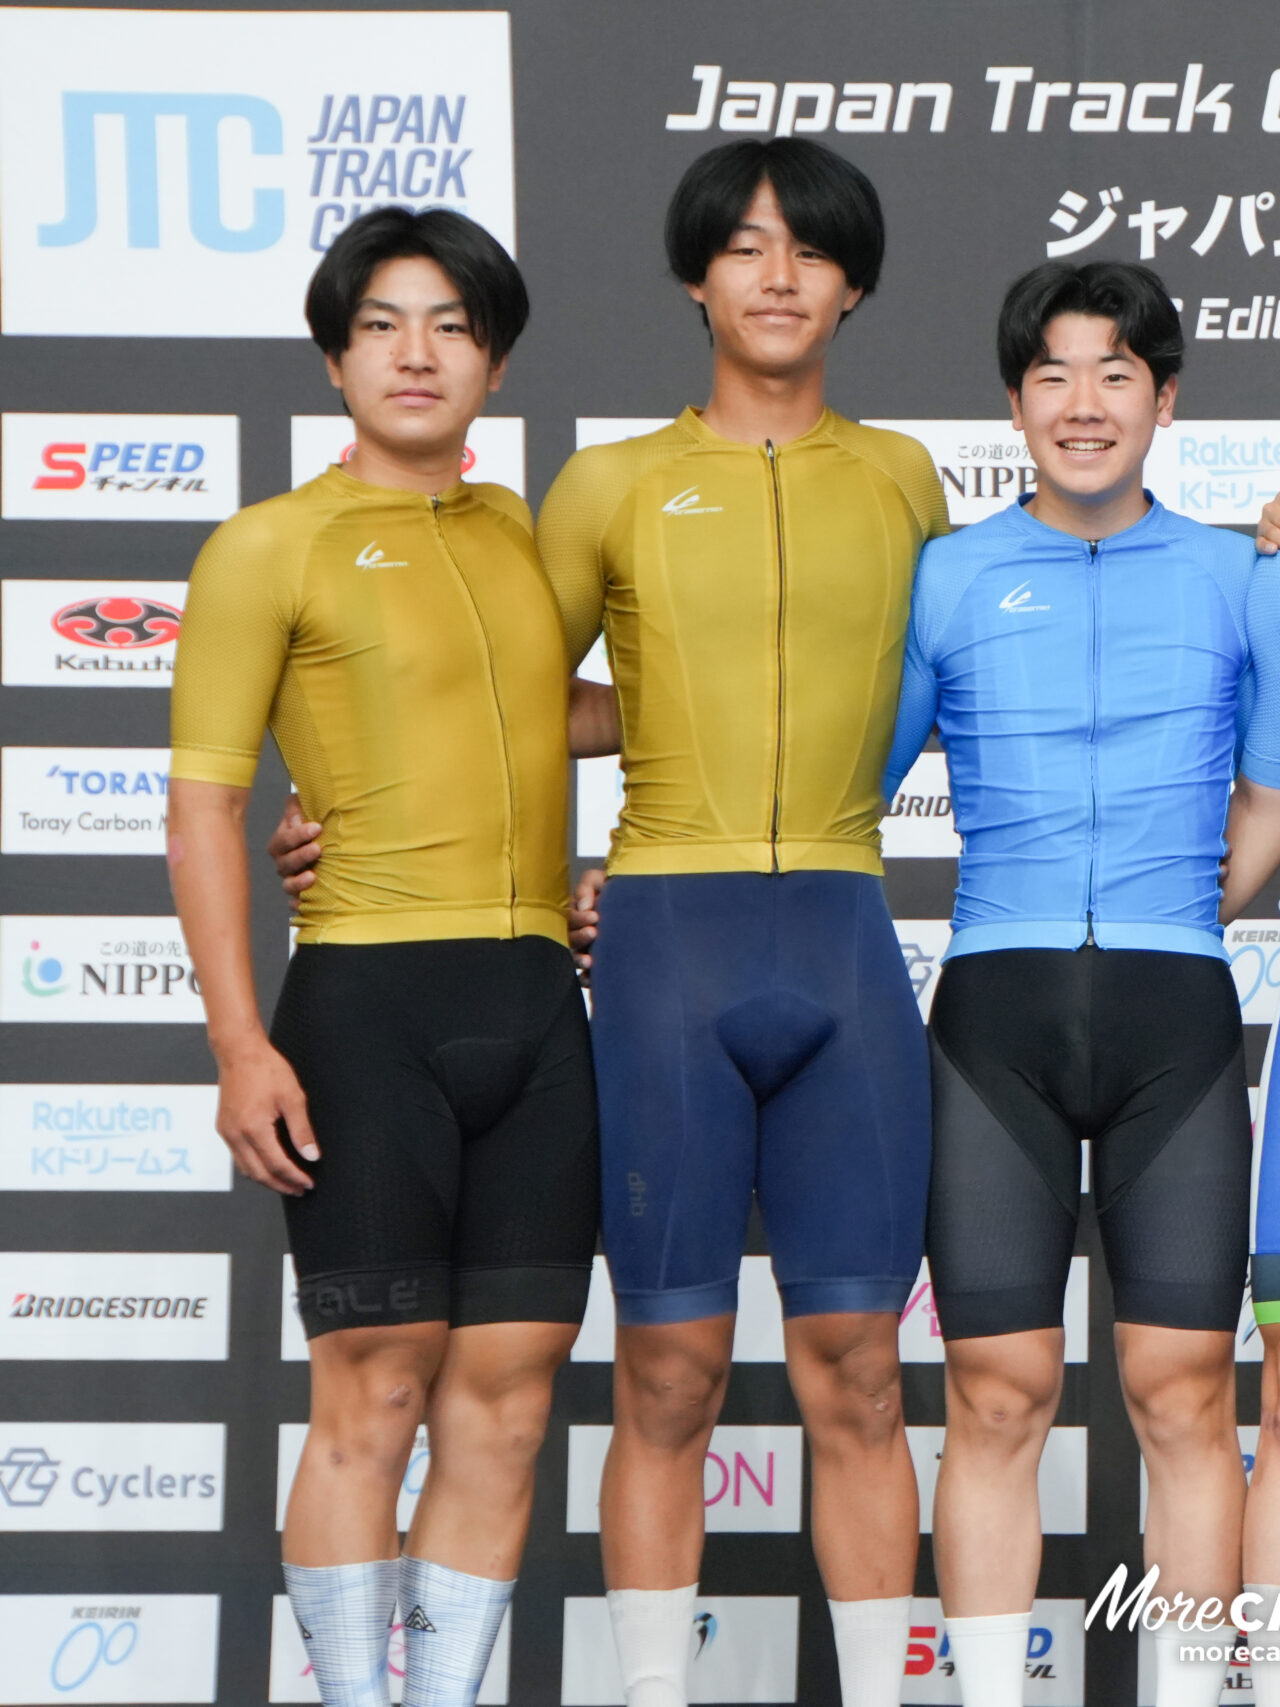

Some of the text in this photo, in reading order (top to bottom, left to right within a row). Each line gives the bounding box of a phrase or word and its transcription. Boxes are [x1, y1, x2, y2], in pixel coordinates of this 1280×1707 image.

[306, 94, 467, 144] JAPAN
[665, 64, 953, 138] Japan
[985, 63, 1235, 133] Track
[36, 90, 286, 254] JTC
[308, 148, 473, 199] TRACK
[33, 442, 205, 490] SPEED
[941, 466, 1038, 499] NIPP
[19, 812, 71, 832] Toray
[78, 811, 154, 832] Carbon
[32, 1101, 171, 1132] Rakuten
[9, 1294, 208, 1318] BRIDGESTONE
[70, 1466, 216, 1508] Cyclers
